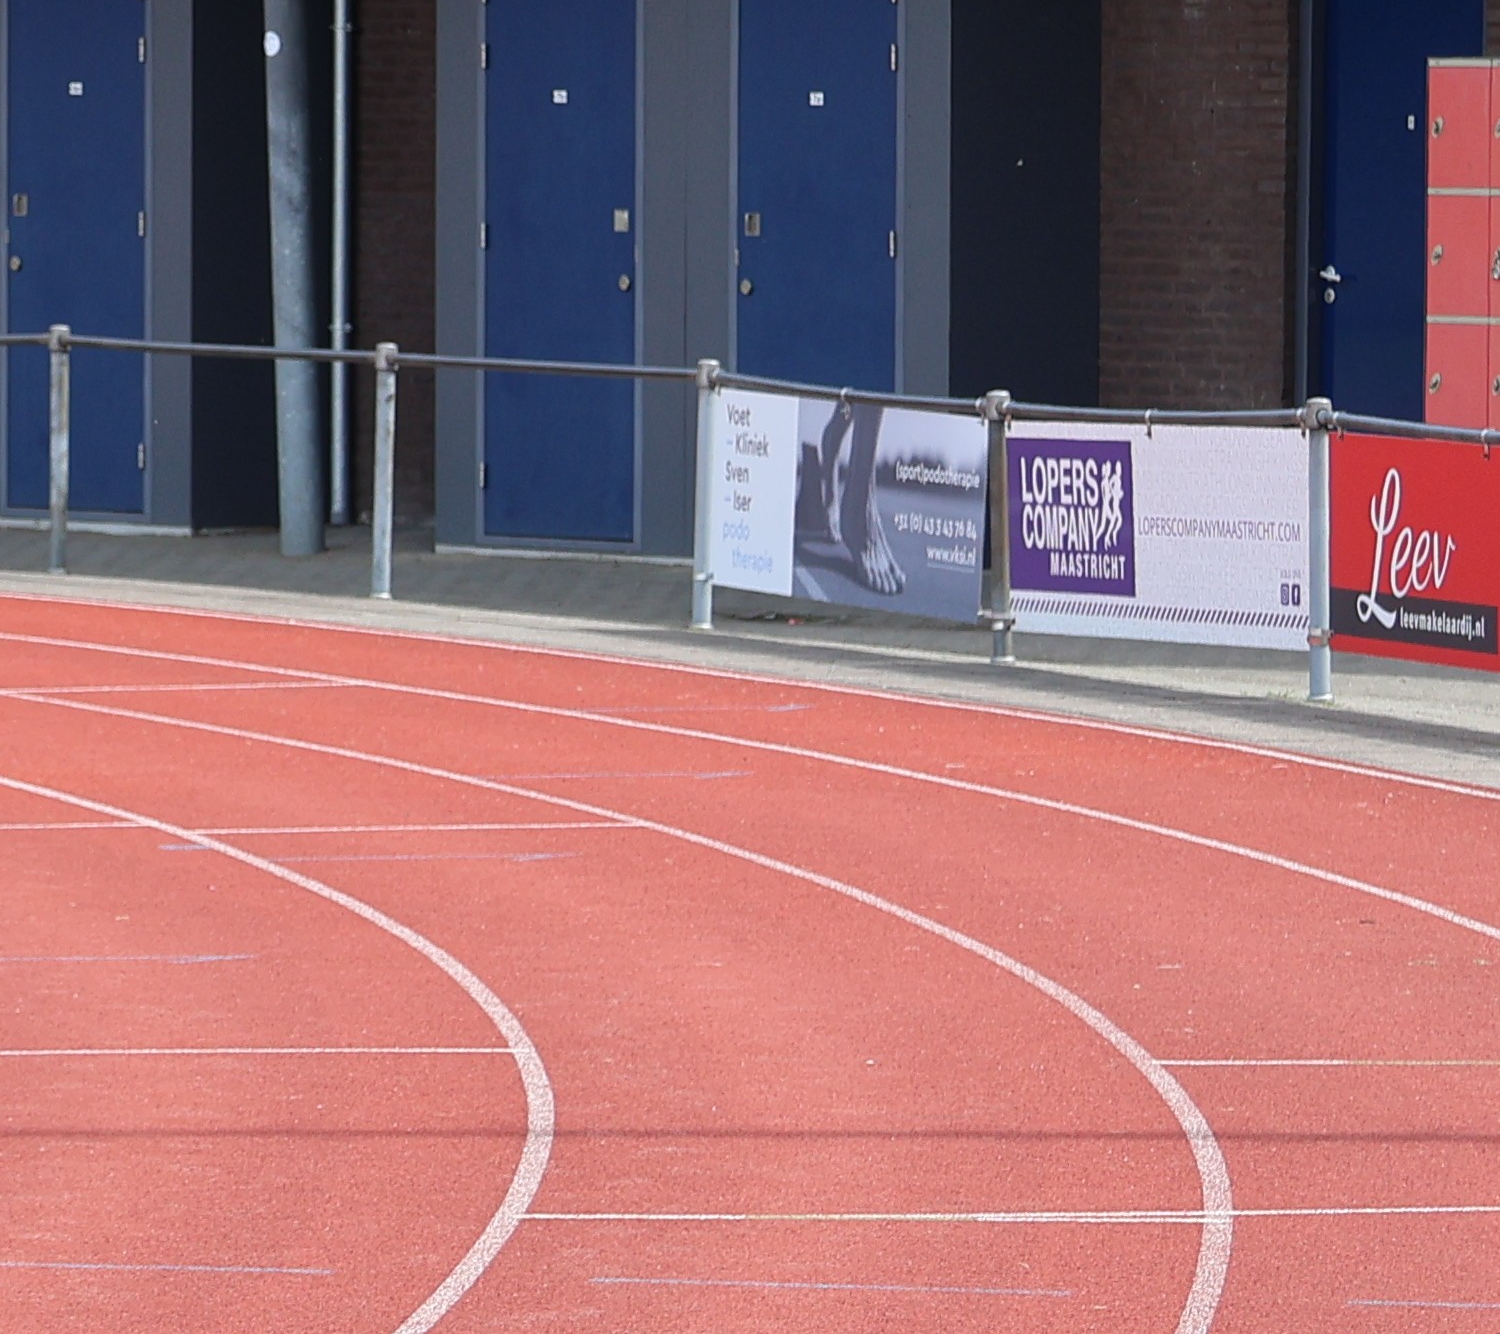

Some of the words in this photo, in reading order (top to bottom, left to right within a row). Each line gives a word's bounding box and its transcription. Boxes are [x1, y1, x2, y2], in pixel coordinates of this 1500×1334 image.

[726, 403, 752, 426] Voet
[735, 433, 770, 458] Kliniek
[725, 460, 750, 483] Sven
[895, 460, 980, 491] (sport)podotherapie
[1020, 456, 1099, 506] LOPERS
[733, 490, 752, 512] Iser
[722, 520, 750, 540] podo
[1022, 503, 1099, 552] COMPANY
[1138, 516, 1301, 542] LOPERSCOMPANYMAASTRICHT.COM
[732, 547, 774, 573] therapie
[1357, 468, 1456, 629] Leev
[1050, 551, 1126, 580] MAASTRICHT
[1400, 606, 1485, 641] leevmakelaardij.nl
